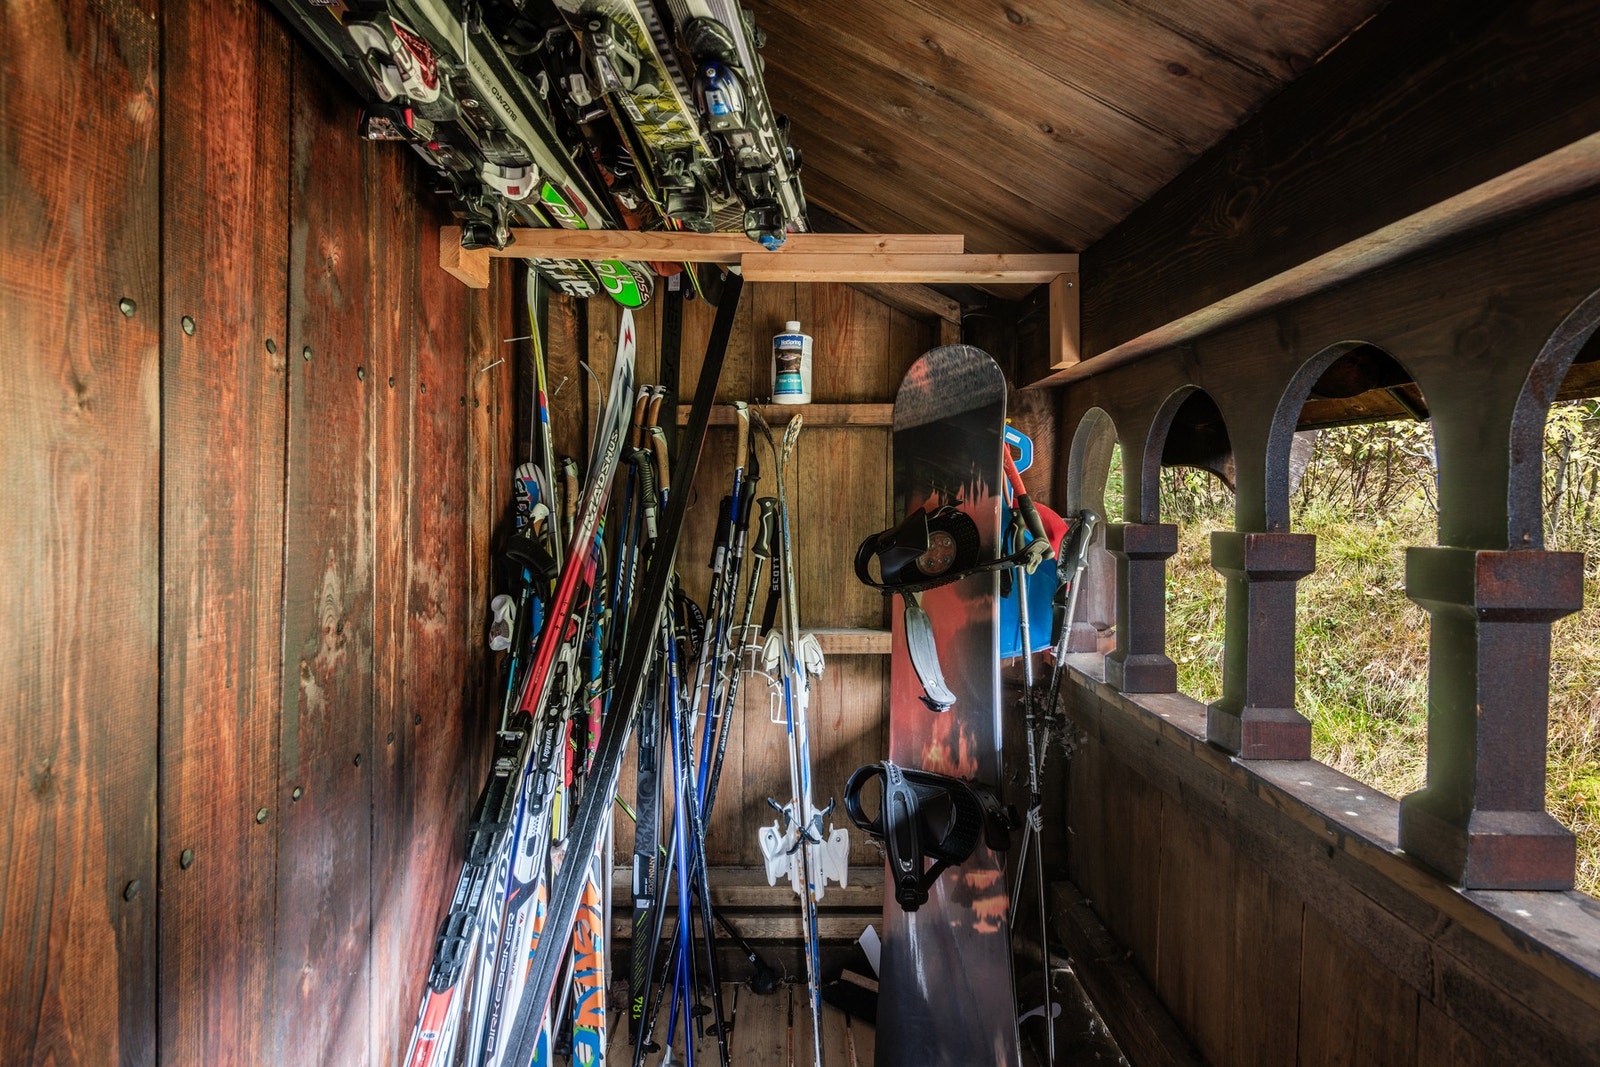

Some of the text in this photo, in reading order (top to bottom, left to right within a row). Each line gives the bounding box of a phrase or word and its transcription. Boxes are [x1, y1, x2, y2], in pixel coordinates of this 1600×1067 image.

[582, 429, 619, 531] MADSHUS
[772, 557, 780, 591] SCOTT
[633, 996, 644, 1020] 184
